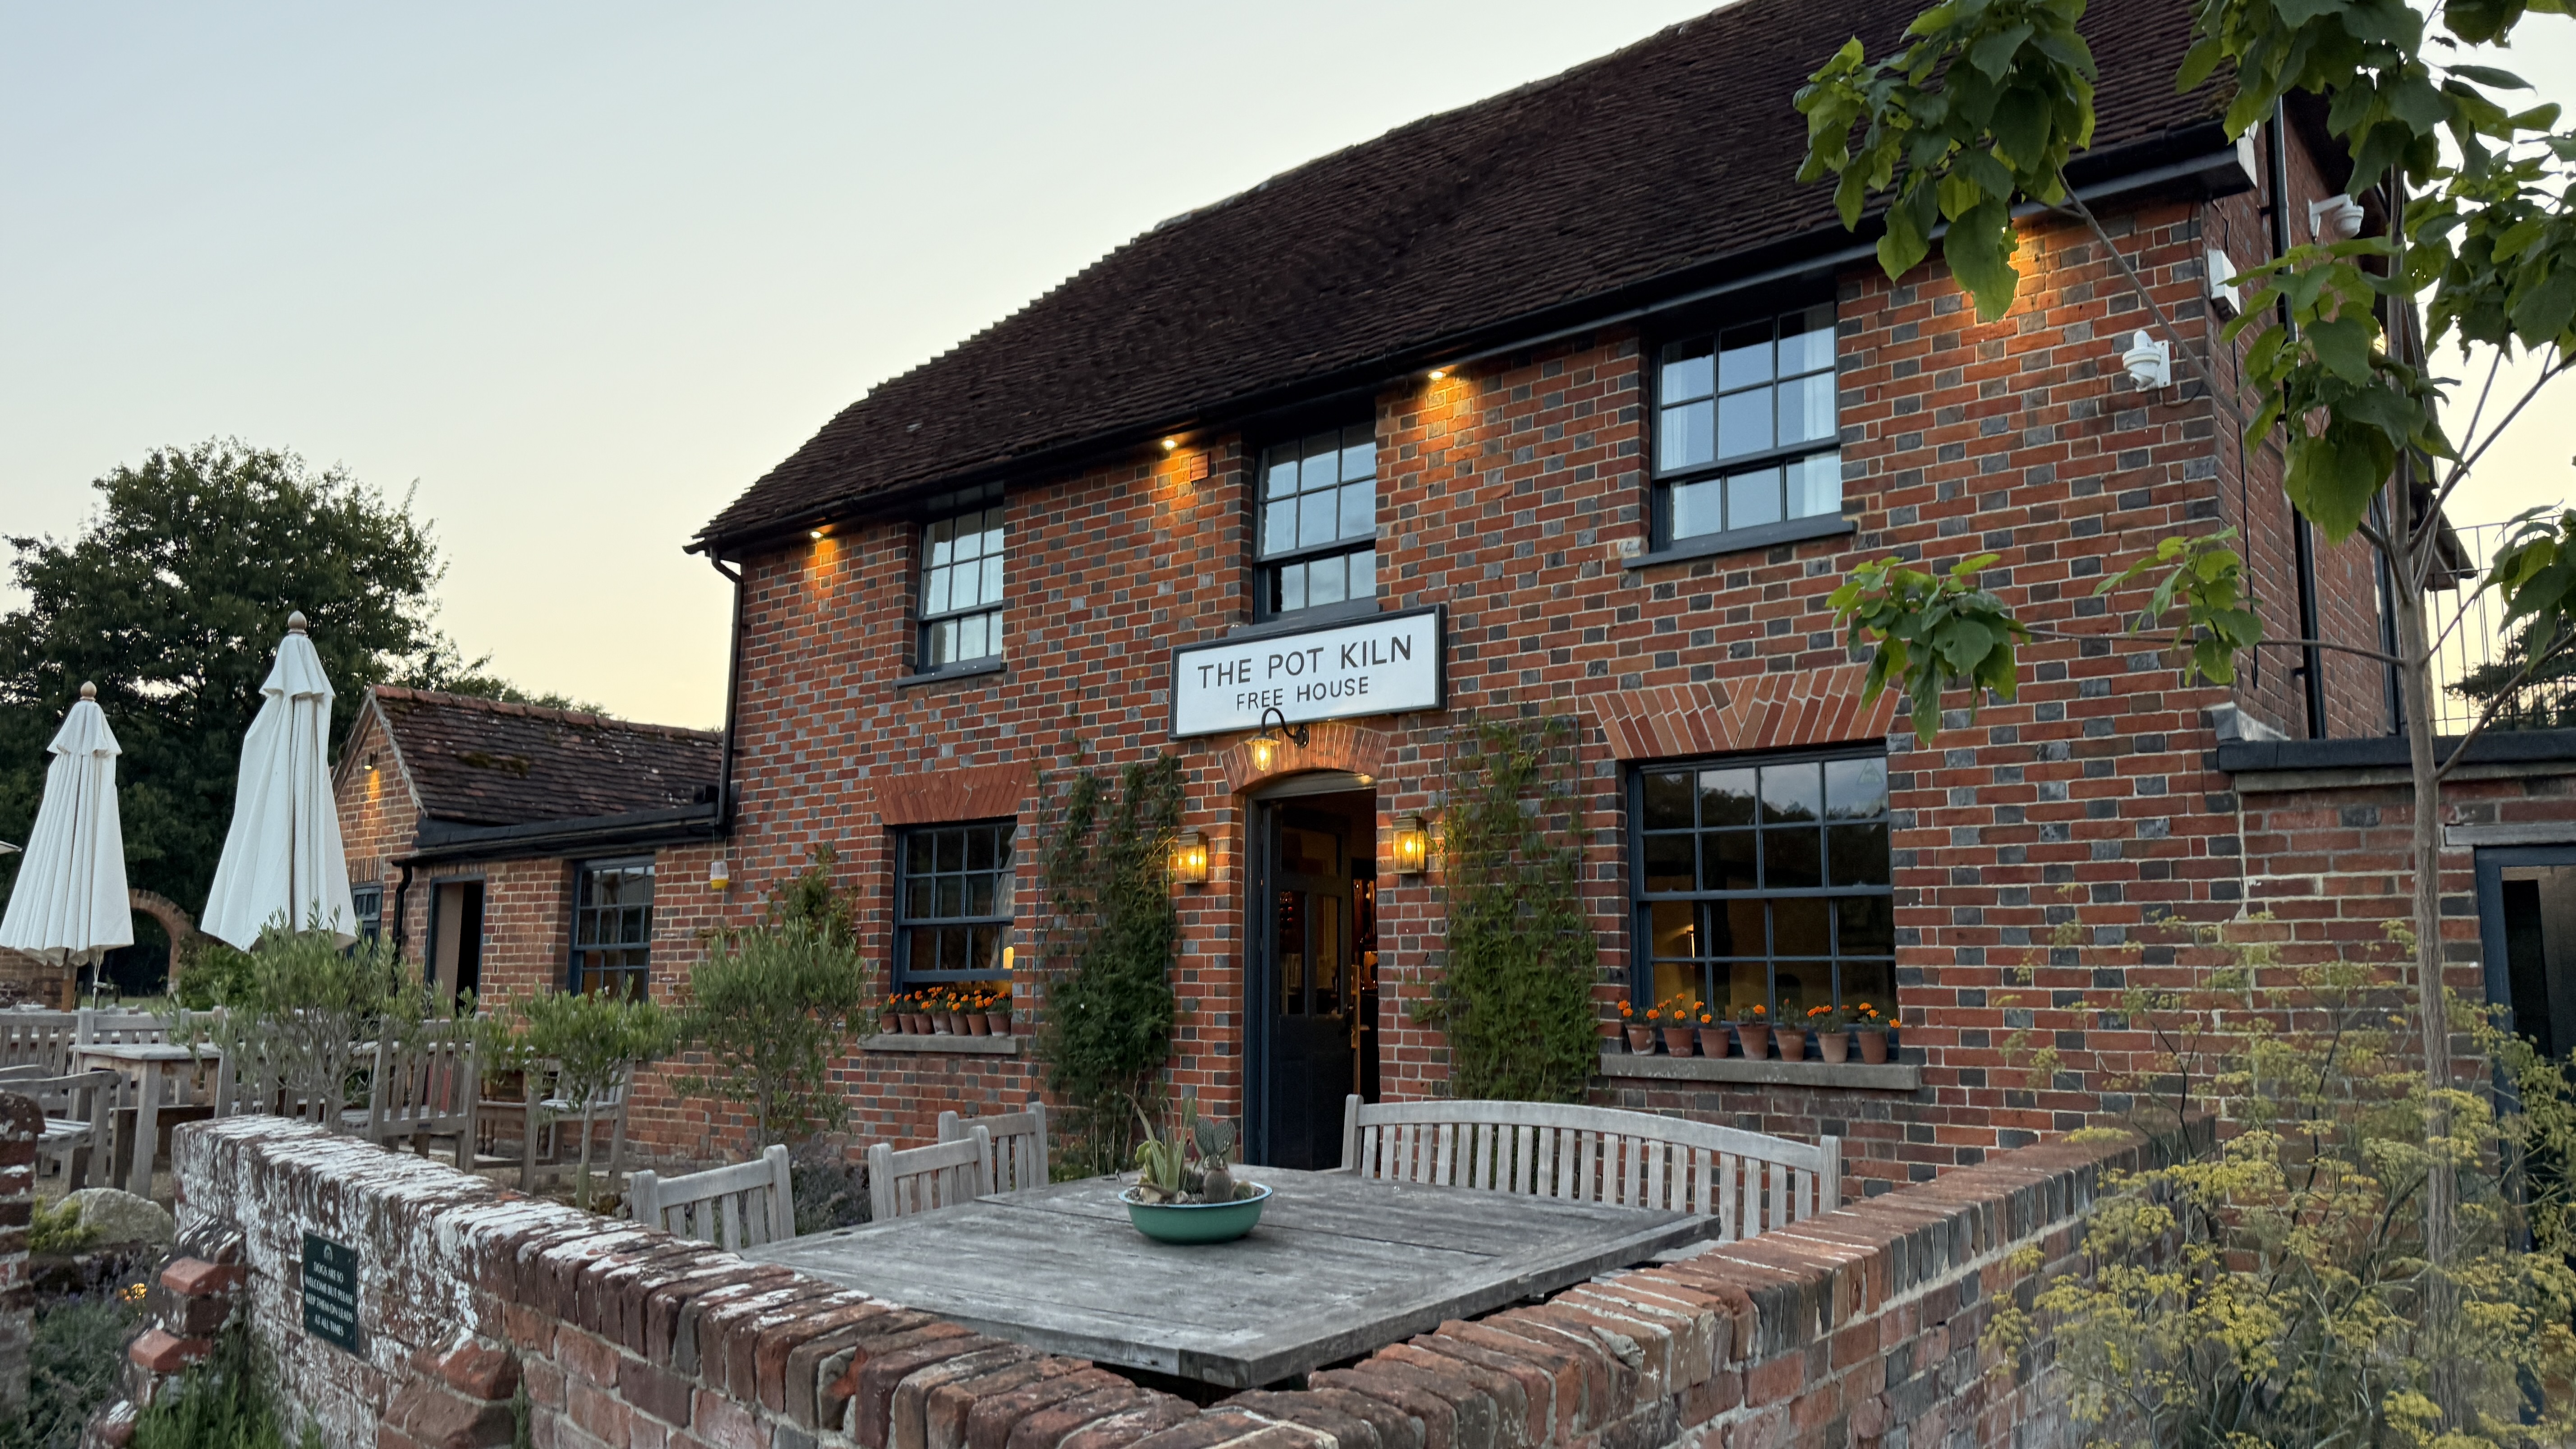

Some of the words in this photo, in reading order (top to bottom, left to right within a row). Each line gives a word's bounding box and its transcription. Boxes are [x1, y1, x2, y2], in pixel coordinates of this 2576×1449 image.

[1197, 658, 1251, 689] THE
[1268, 647, 1324, 679] POT
[1341, 635, 1411, 669] KILN
[1237, 688, 1283, 711] FREE
[1297, 676, 1368, 703] HOUSE
[314, 1261, 327, 1277] DOGS
[327, 1267, 336, 1281] ARE
[337, 1270, 344, 1284] SO
[305, 1274, 327, 1294] WELCOME
[327, 1284, 337, 1298] BUT
[338, 1289, 353, 1306] PLEASE
[306, 1293, 316, 1306] KEEP
[317, 1297, 329, 1312] THEM
[330, 1303, 338, 1316] ON
[338, 1307, 353, 1324] LEADS
[314, 1314, 320, 1326] AT
[321, 1317, 329, 1330] ALL
[330, 1320, 344, 1337] TIMES
